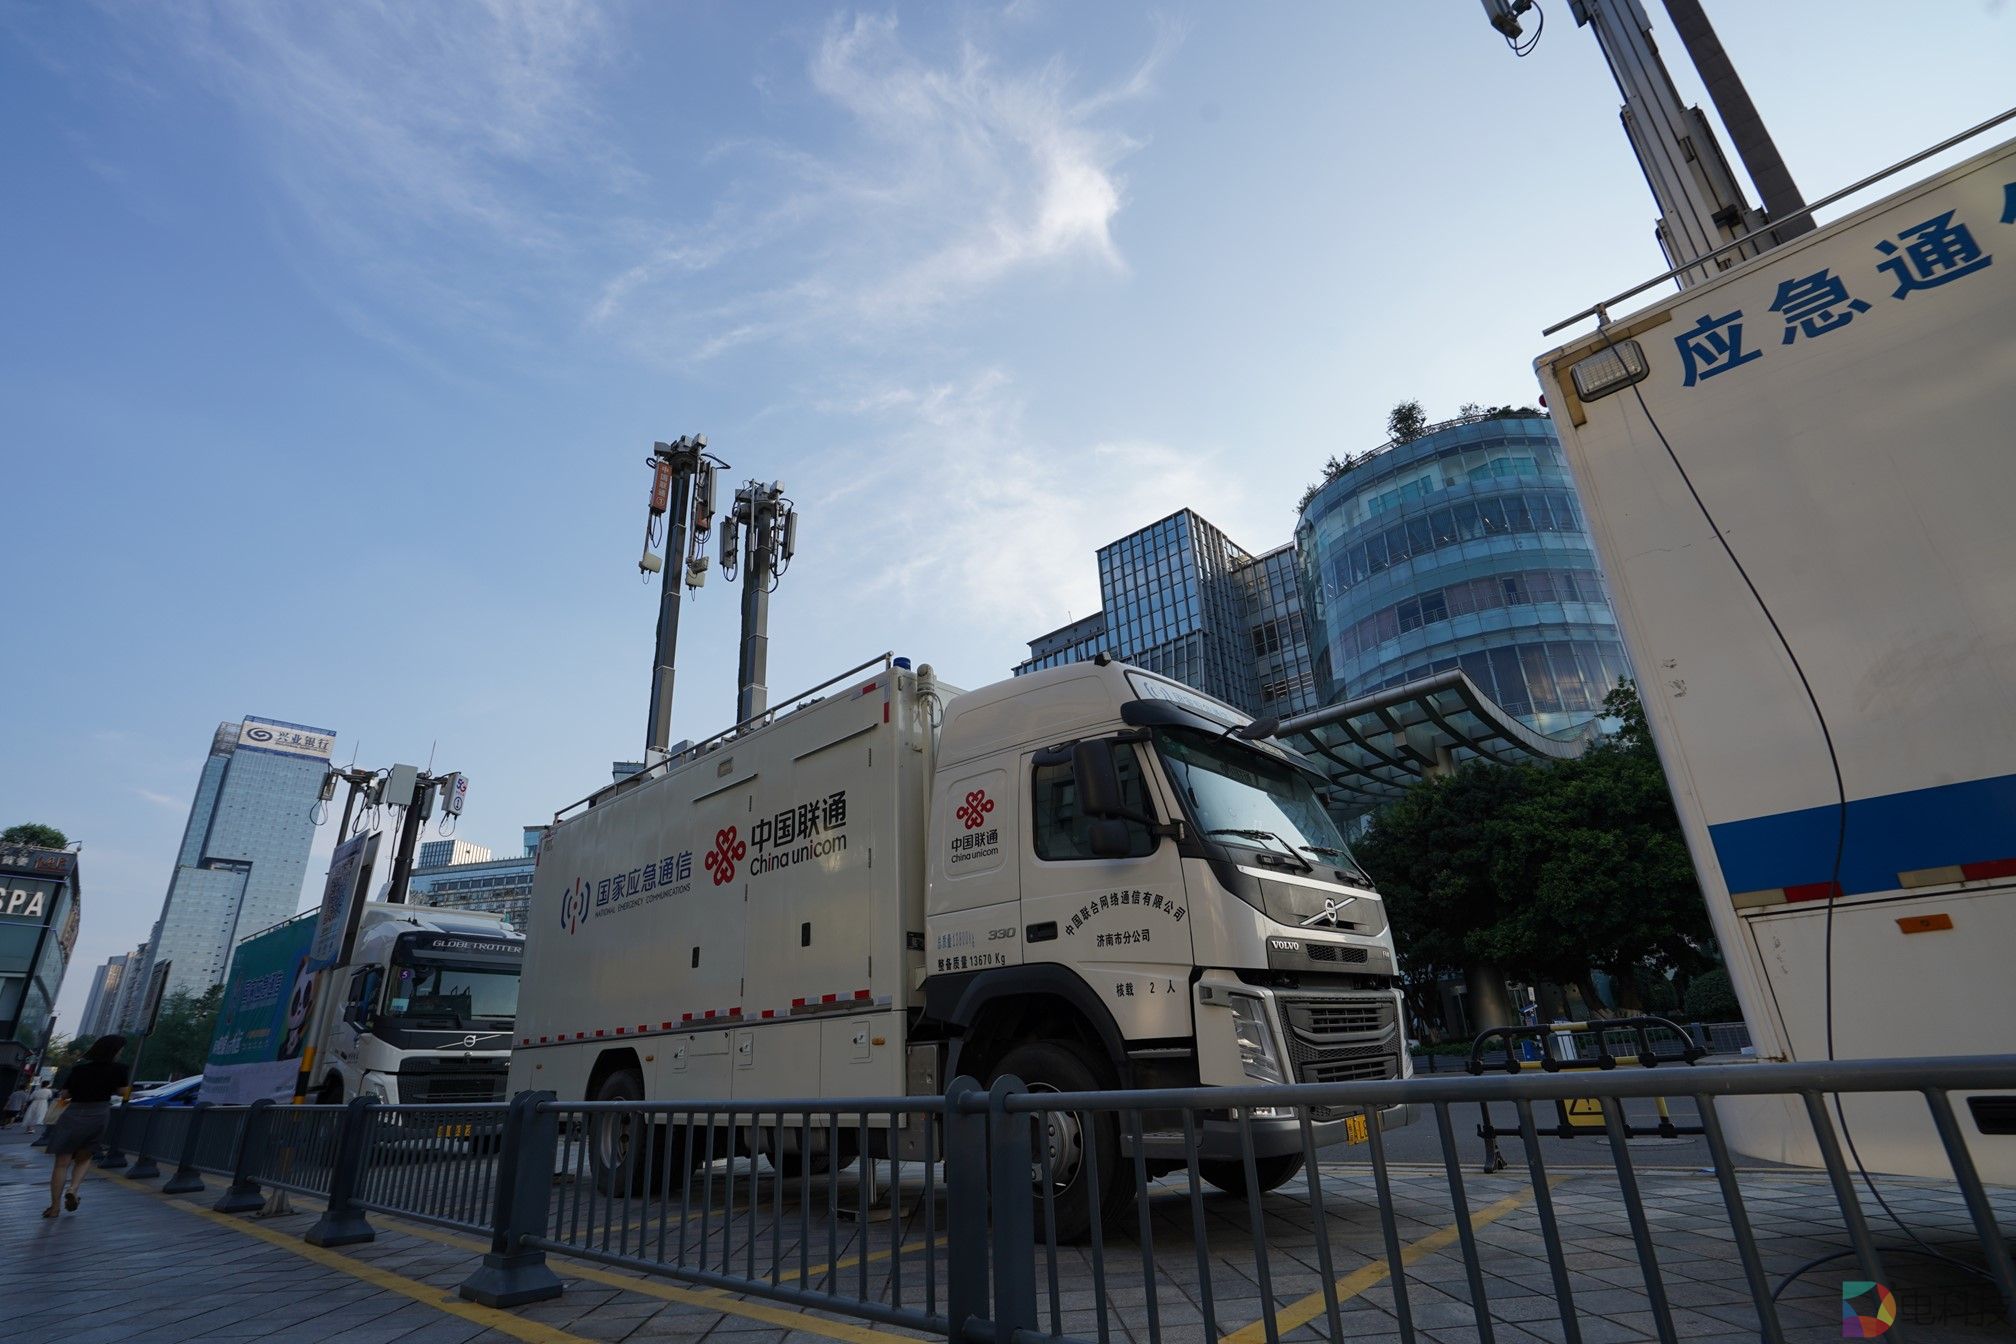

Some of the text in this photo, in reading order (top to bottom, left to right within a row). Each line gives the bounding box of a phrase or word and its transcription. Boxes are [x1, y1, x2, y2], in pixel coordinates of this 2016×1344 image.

[277, 731, 329, 750] 兴业银行
[456, 778, 467, 792] 5G
[751, 790, 847, 853] 中国联通
[951, 829, 998, 852] 中国联通
[750, 834, 847, 876] China unicom
[951, 847, 999, 864] China unicom
[596, 850, 693, 907] 国家应急通信
[1065, 890, 1186, 937] 中国联合网络通信有限公司
[988, 927, 1017, 941] 330
[1096, 928, 1151, 947] 济南市分公司
[432, 940, 522, 953] GLOBETROTTER
[1271, 940, 1299, 951] VOLVO
[938, 952, 1006, 972] 整备质量 13670 Kg
[1116, 979, 1175, 997] 核载 2 人
